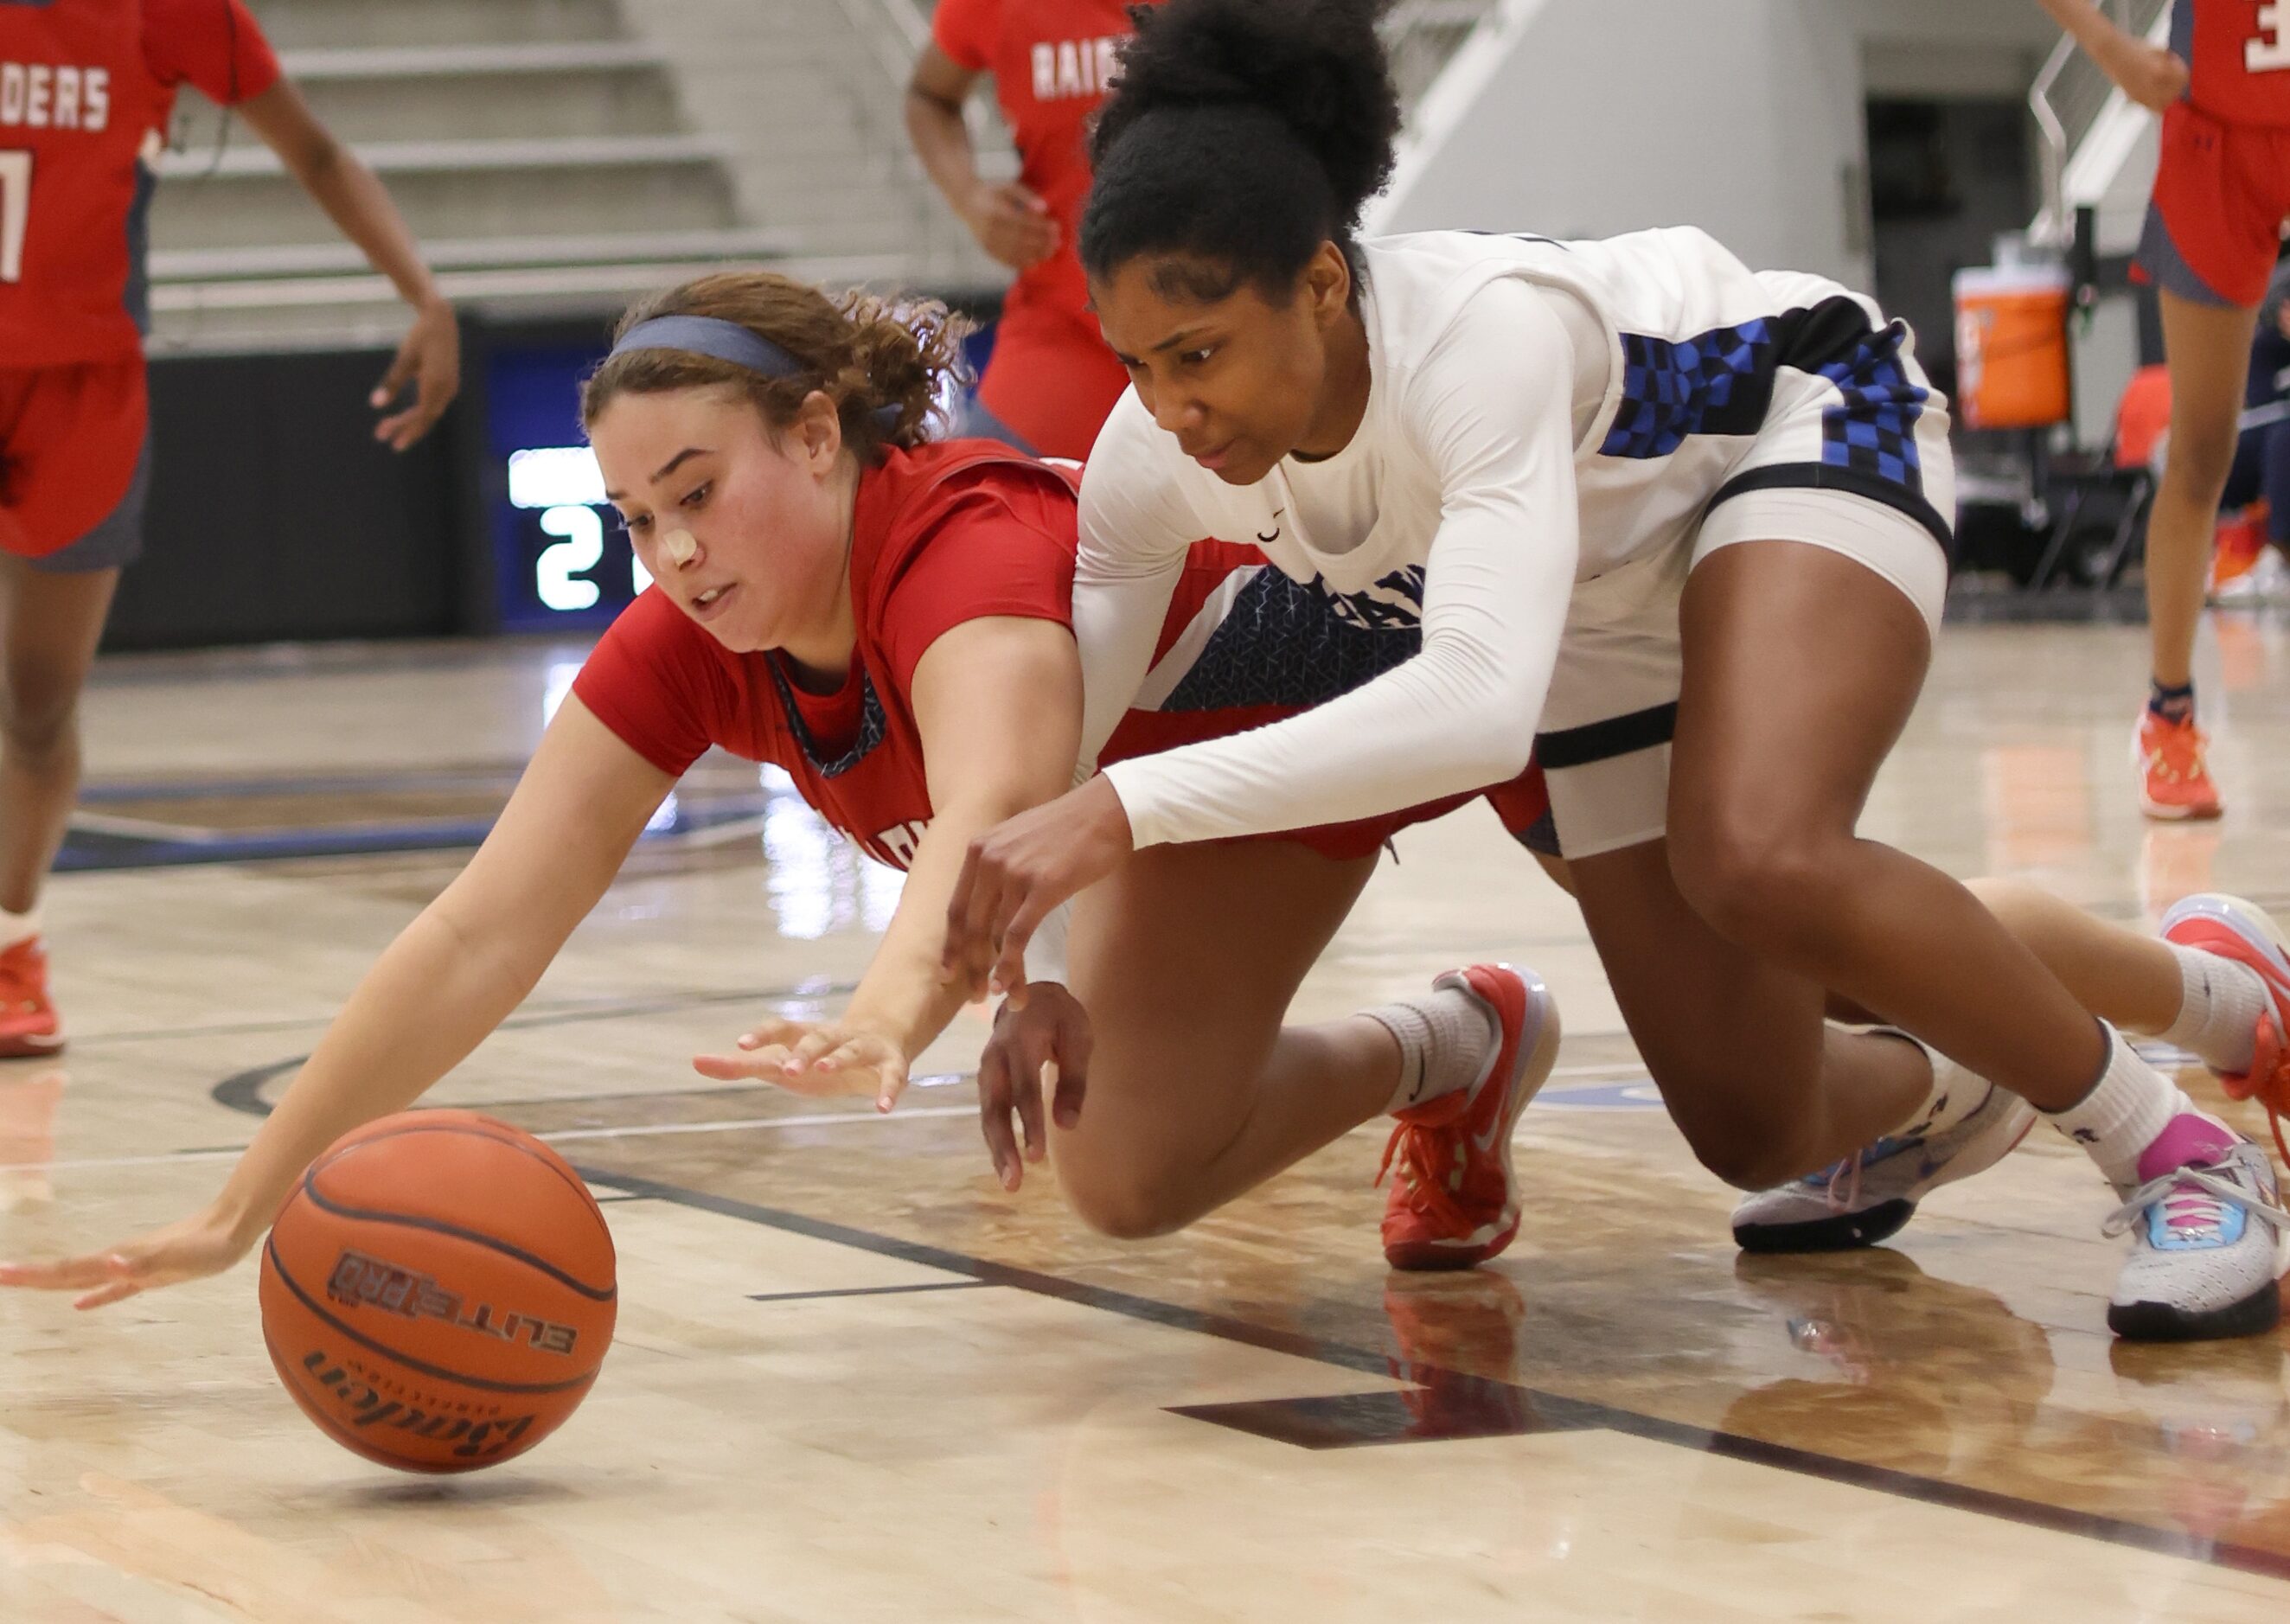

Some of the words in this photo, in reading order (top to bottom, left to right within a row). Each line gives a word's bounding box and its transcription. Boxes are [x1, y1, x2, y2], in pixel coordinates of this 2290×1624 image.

[1030, 37, 1126, 102] RAID
[536, 504, 655, 611] 2
[329, 1252, 415, 1315] PRO
[421, 1290, 579, 1357] ELITE
